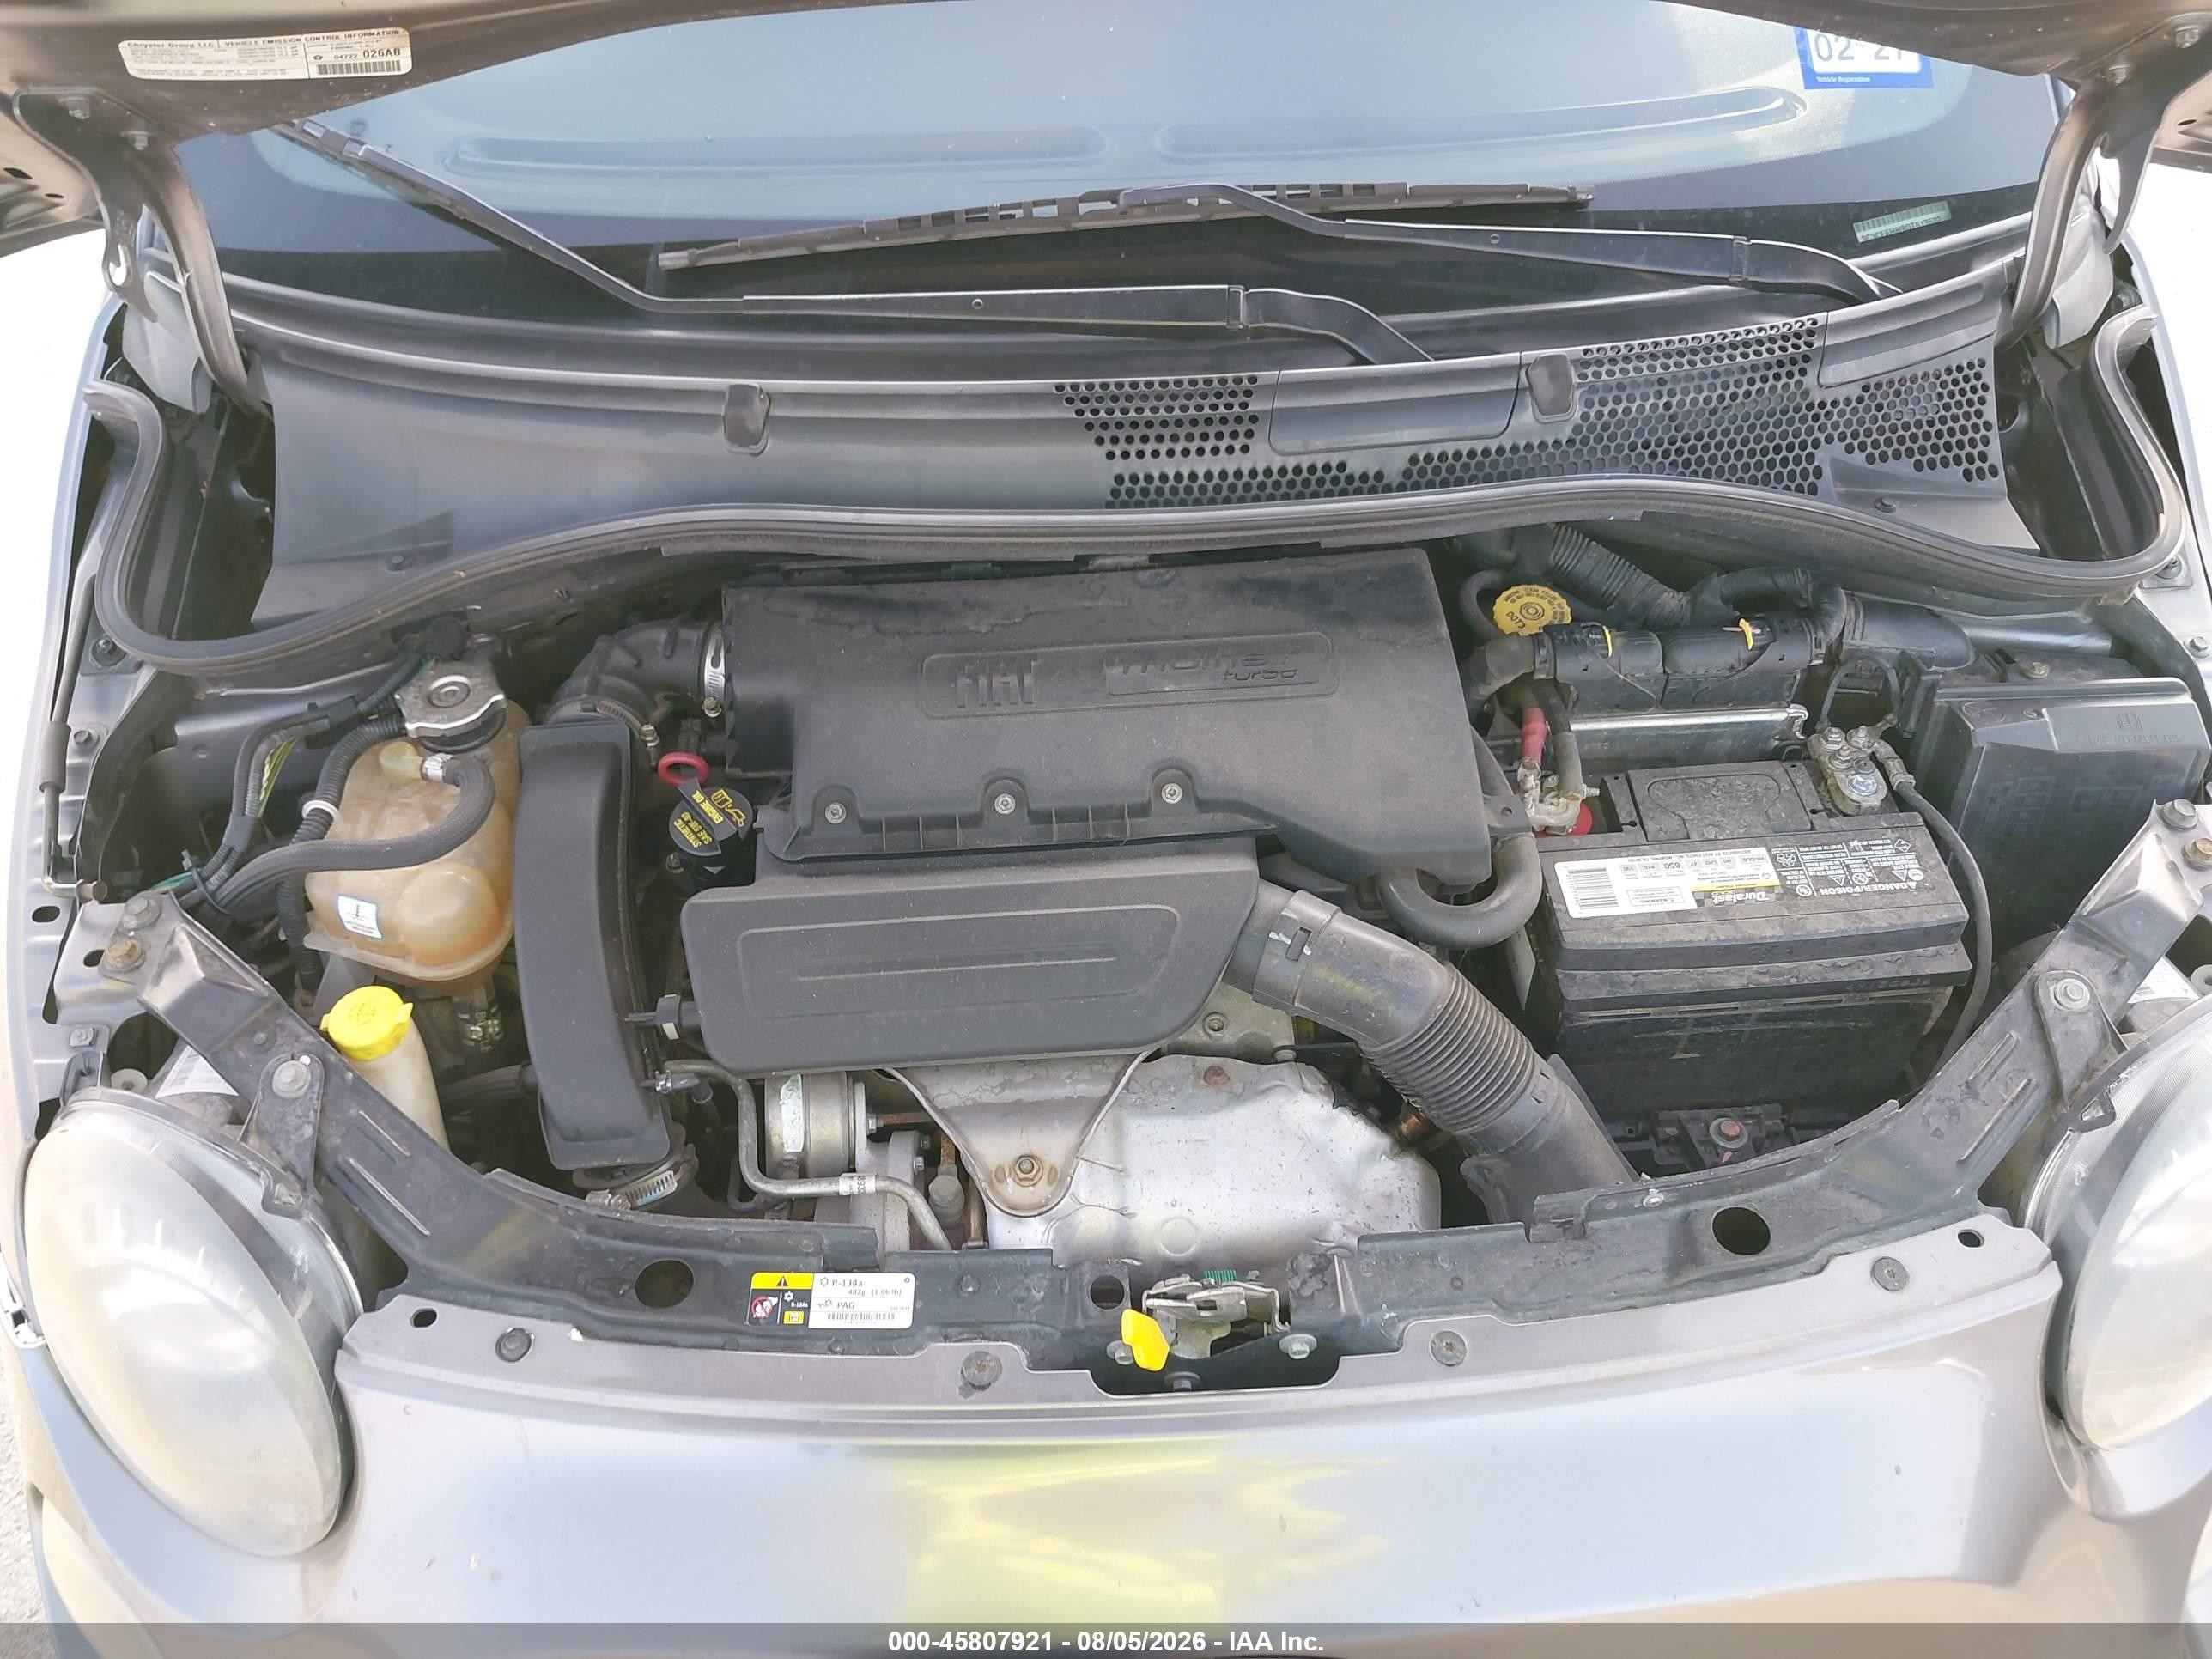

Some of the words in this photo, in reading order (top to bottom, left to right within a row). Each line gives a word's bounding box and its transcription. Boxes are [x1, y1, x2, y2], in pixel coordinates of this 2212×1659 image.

[225, 39, 258, 48] VEHICLE
[262, 37, 301, 46] EMISSION
[305, 33, 342, 43] CONTROL
[344, 30, 400, 40] INFORMATION
[362, 47, 402, 58] 026AB
[1838, 76, 1870, 84] Registration
[1224, 669, 1299, 681] turbo
[690, 788, 705, 804] OIL
[700, 799, 725, 825] ENGINE
[697, 828, 713, 845] SAE
[1664, 861, 1681, 870] 650
[1819, 882, 1909, 896] DANGER/POISON
[1711, 890, 1770, 905] Duralast
[832, 1277, 863, 1287] R-134a
[837, 1301, 856, 1310] PAG
